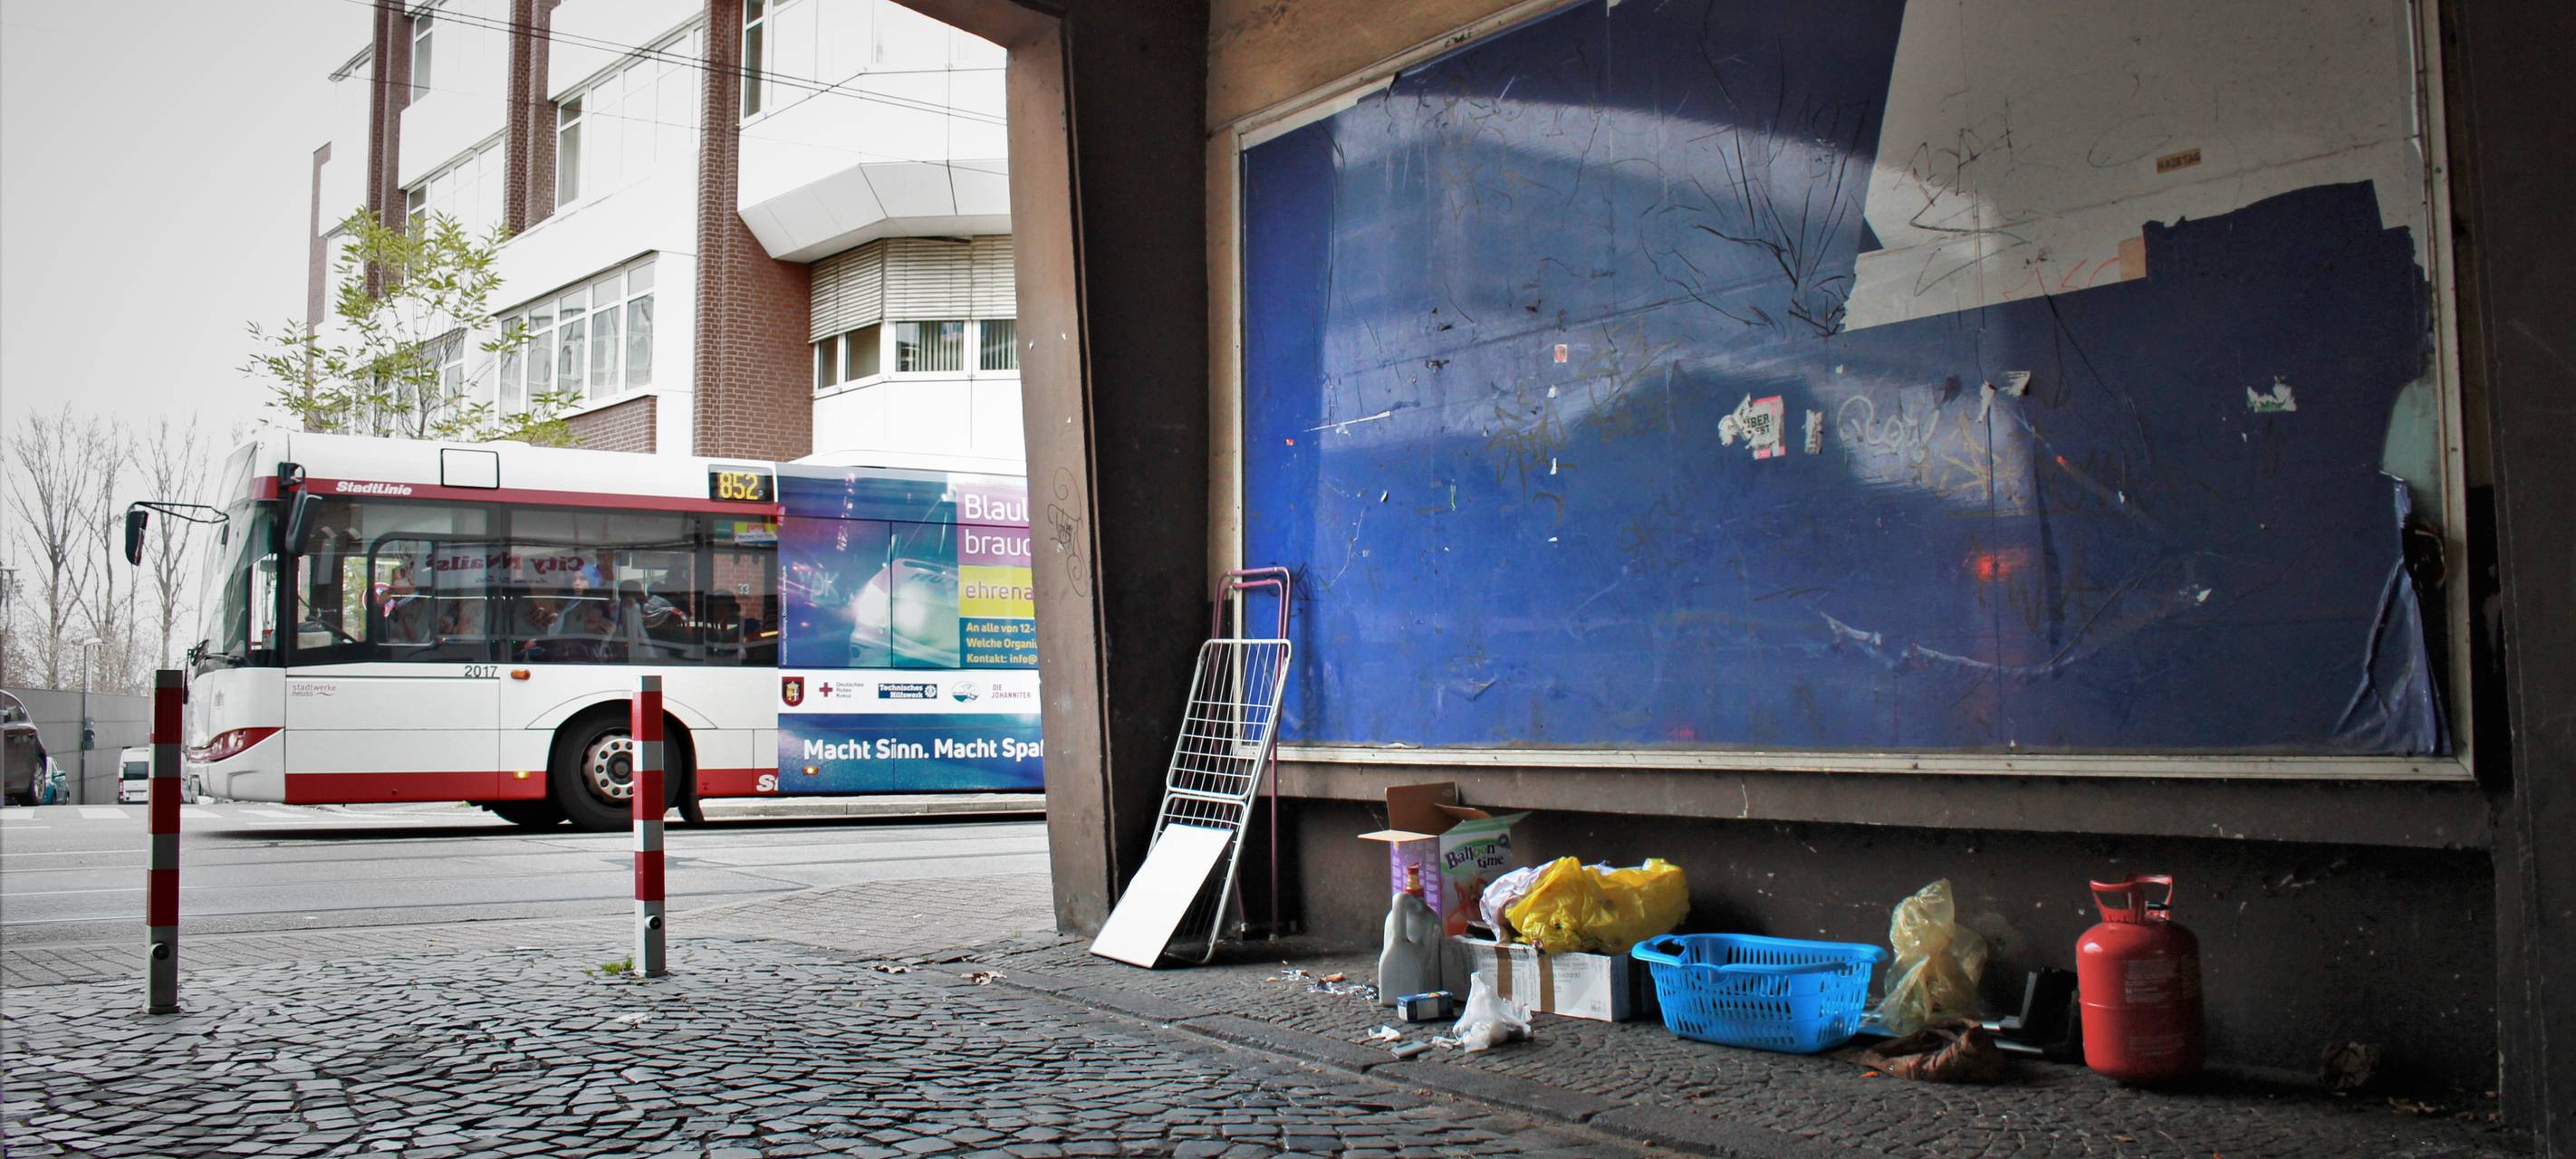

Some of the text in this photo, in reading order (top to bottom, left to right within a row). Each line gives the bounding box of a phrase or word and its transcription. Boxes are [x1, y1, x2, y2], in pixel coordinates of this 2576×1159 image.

[336, 481, 412, 495] StadtLinie
[719, 472, 758, 500] 852
[965, 529, 1031, 556] brauc
[966, 580, 1034, 600] ehrena
[966, 622, 1036, 633] An alle von 12-
[966, 637, 1002, 648] Welche
[966, 653, 1038, 665] Kontakt: info@
[465, 666, 498, 678] 2017
[879, 683, 924, 691] Technisches
[803, 738, 870, 760] Macht
[875, 738, 929, 759] Sinn.
[934, 738, 997, 759] Macht
[1445, 843, 1495, 869] Balloon
[1476, 855, 1504, 869] time
